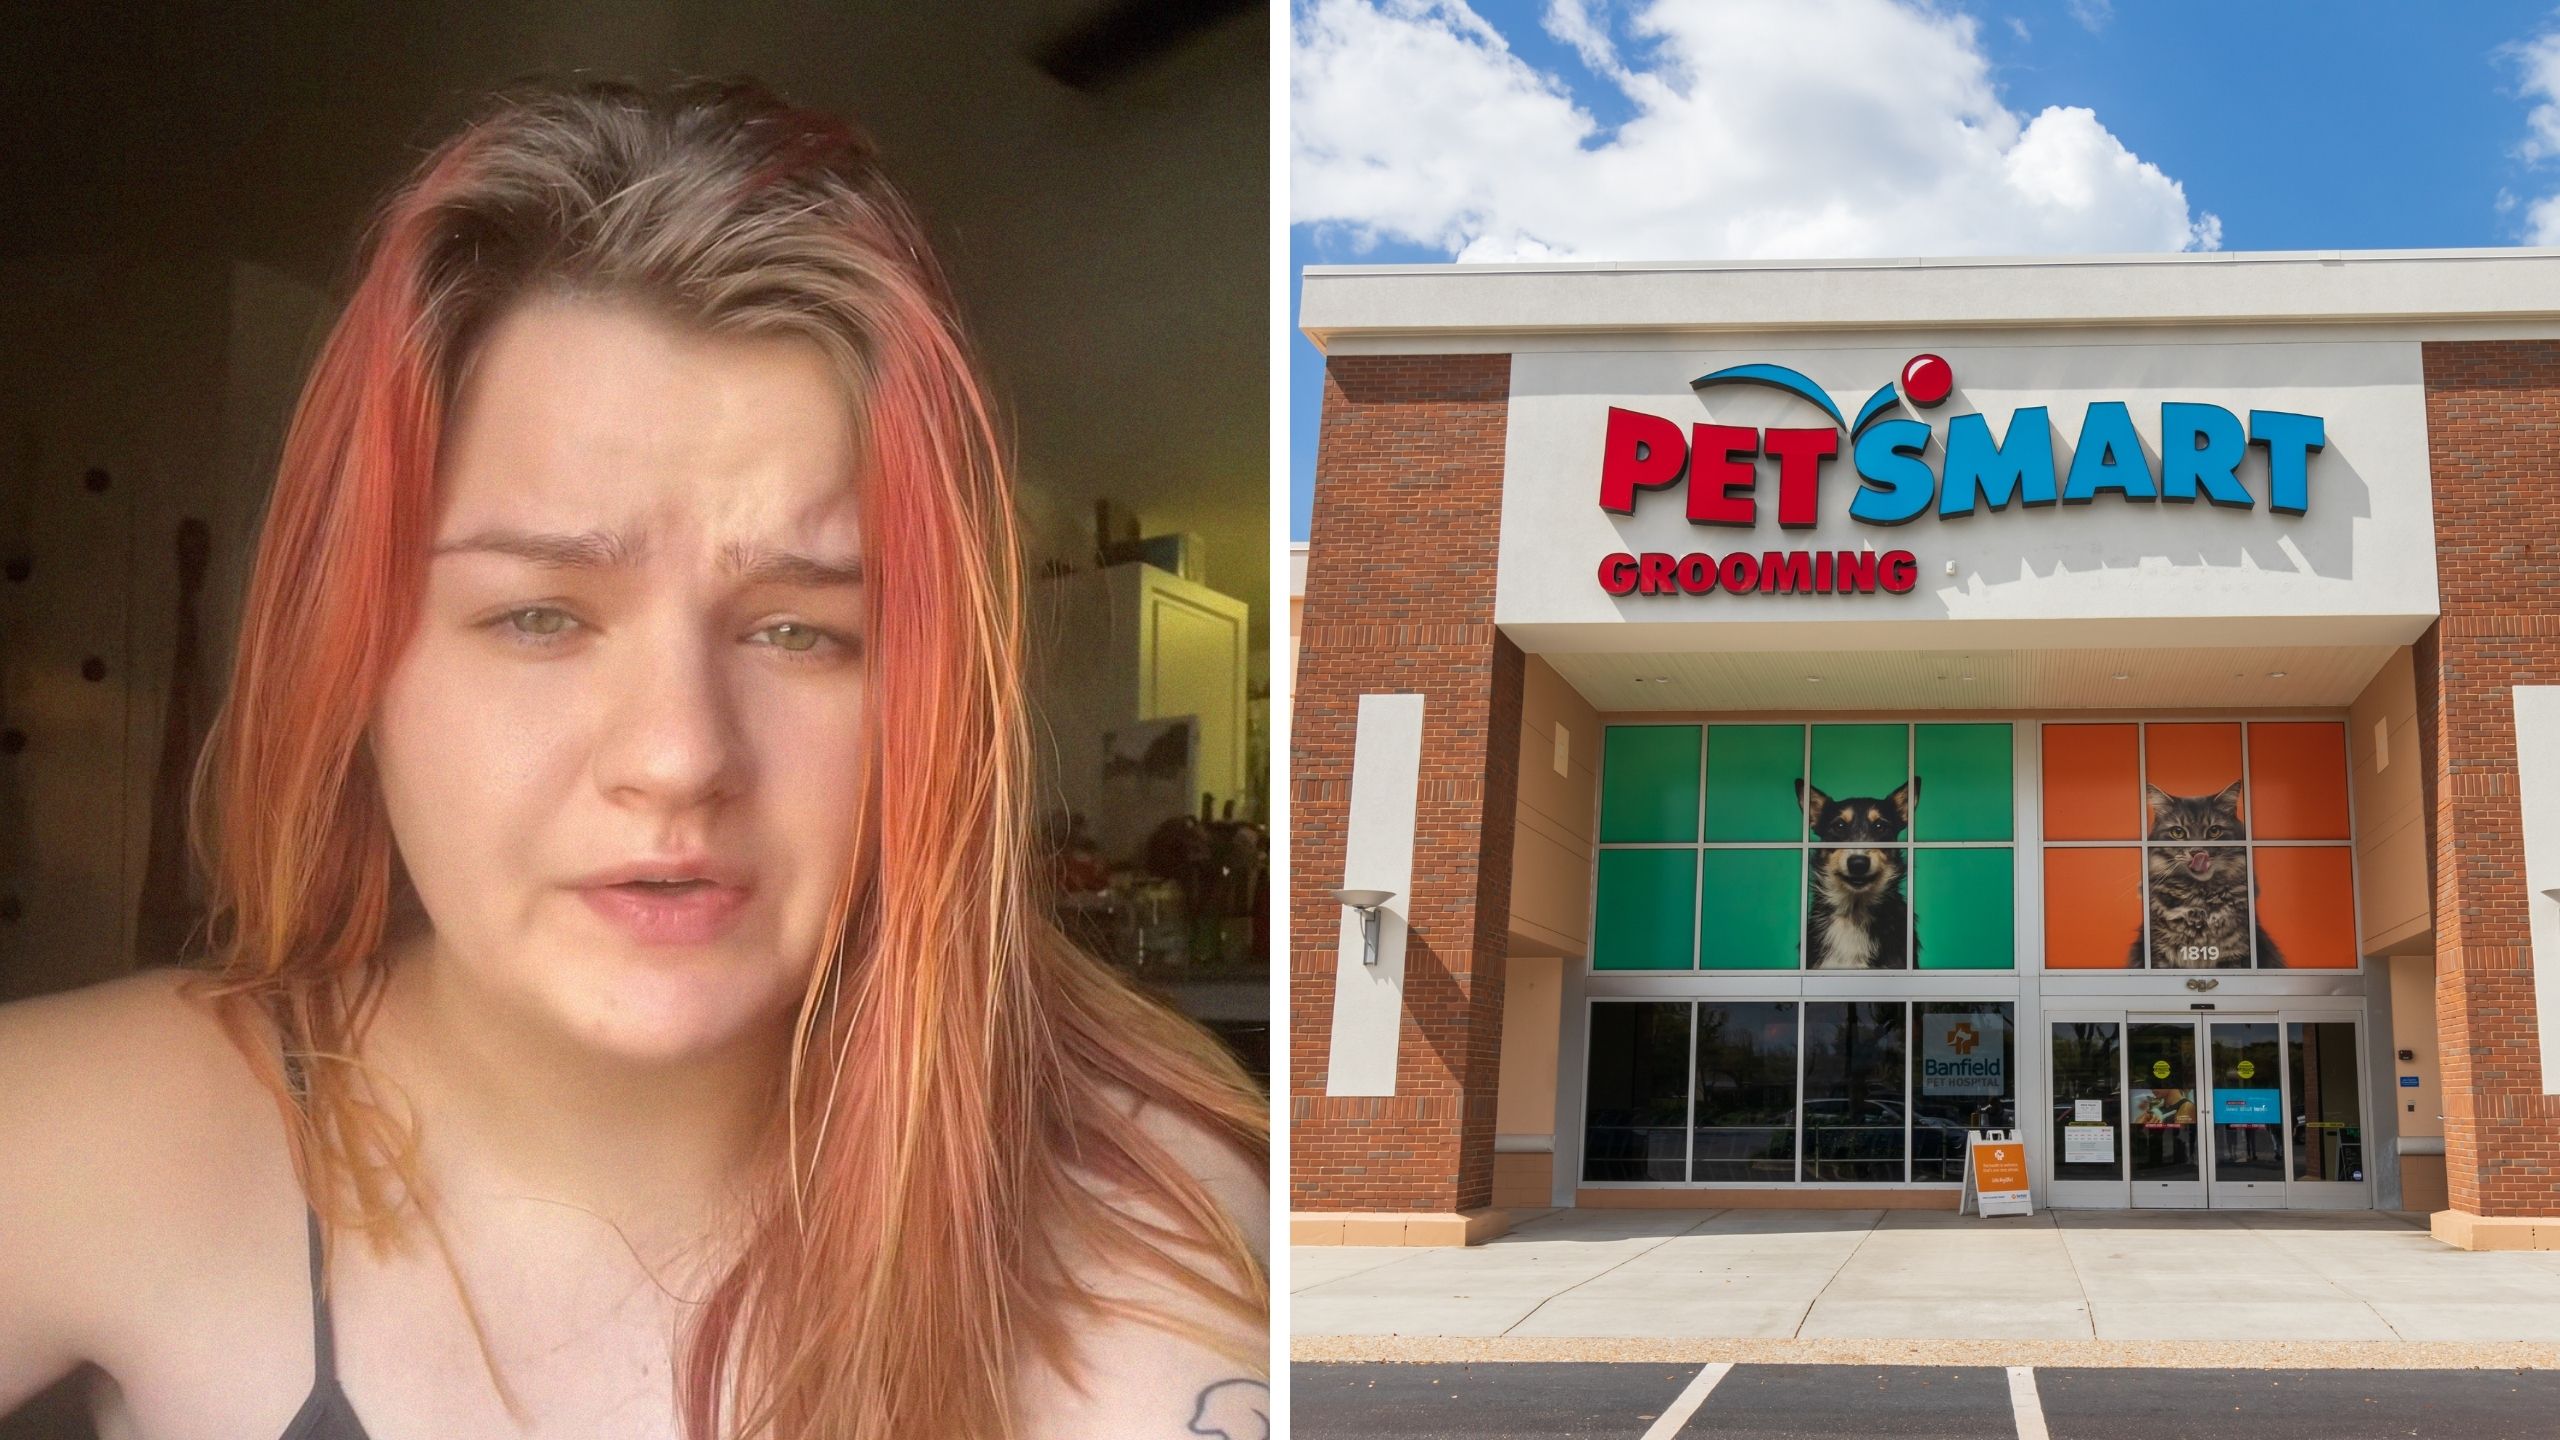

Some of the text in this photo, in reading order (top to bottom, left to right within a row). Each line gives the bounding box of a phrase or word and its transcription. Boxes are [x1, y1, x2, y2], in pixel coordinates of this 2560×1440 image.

[1599, 401, 2325, 530] PETSMART
[1597, 549, 1919, 596] GROOMING
[2180, 946, 2220, 961] 1819
[1925, 1057, 2001, 1076] Banfield
[1926, 1077, 2001, 1088] PET HOSPITAL
